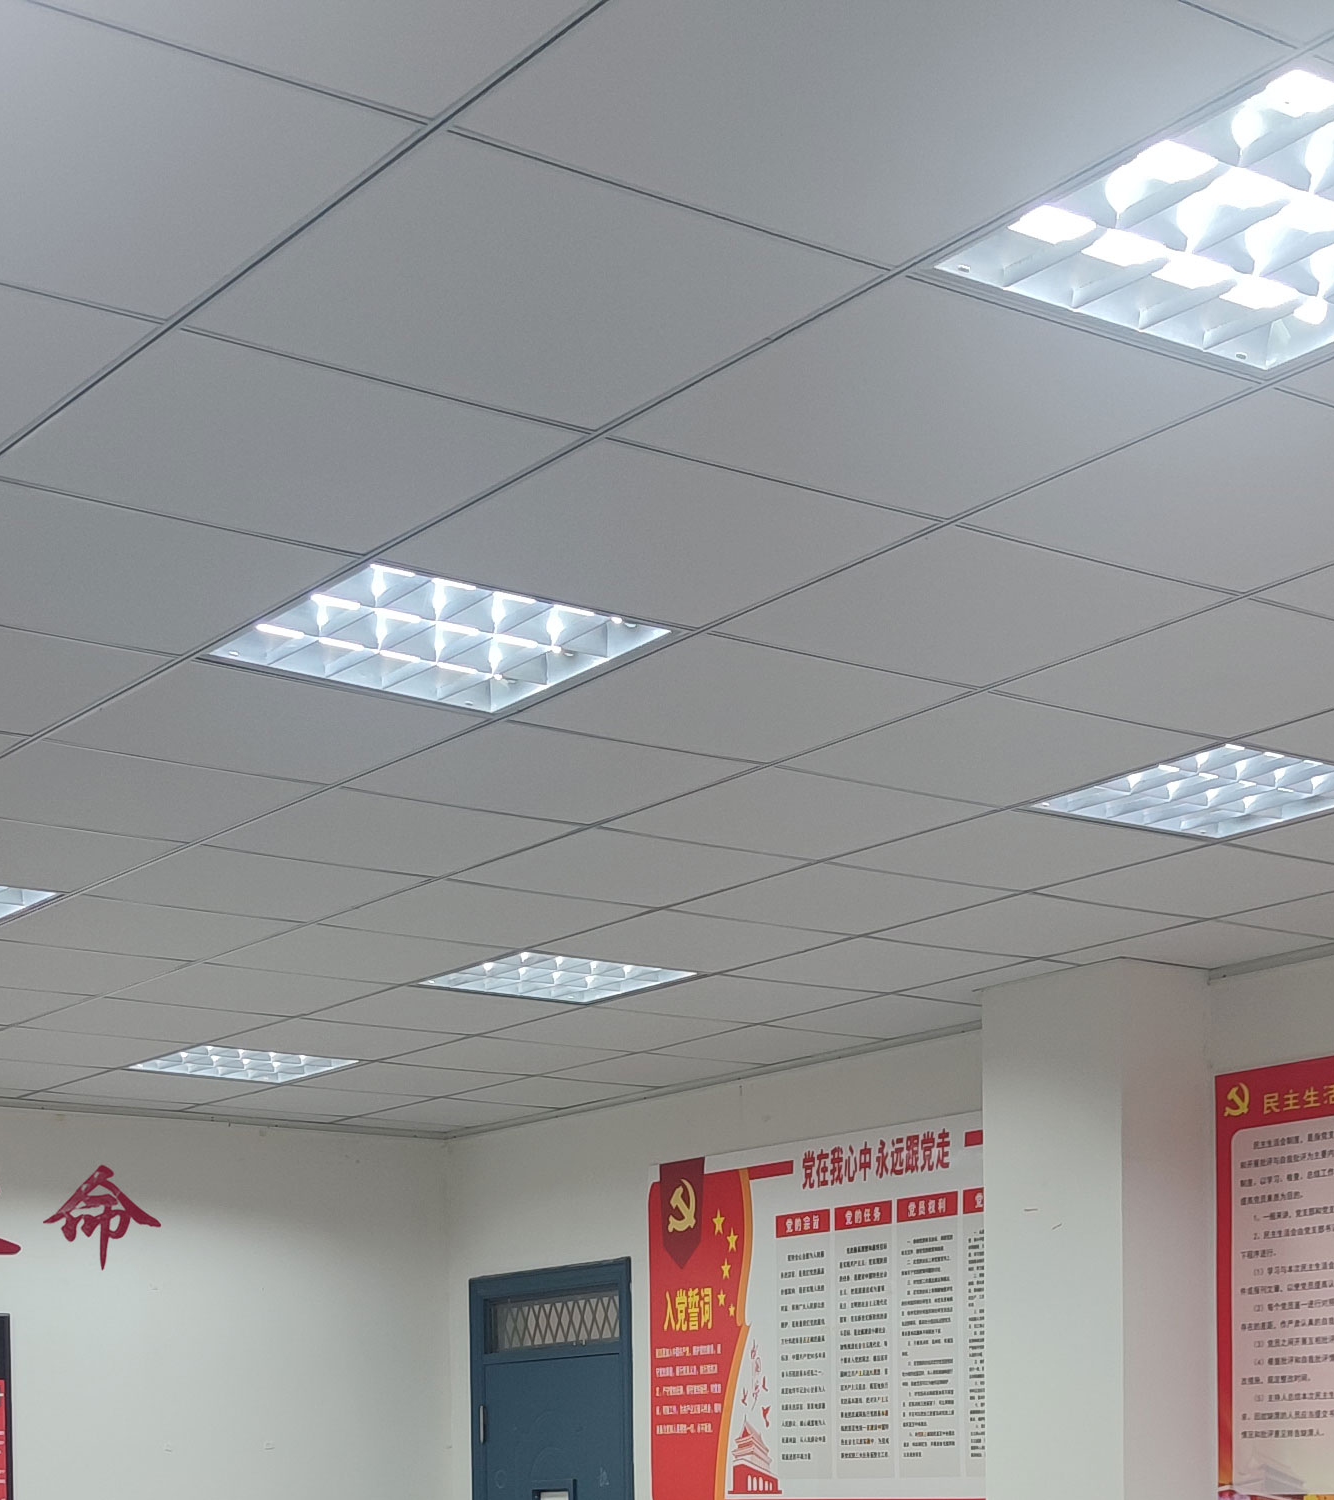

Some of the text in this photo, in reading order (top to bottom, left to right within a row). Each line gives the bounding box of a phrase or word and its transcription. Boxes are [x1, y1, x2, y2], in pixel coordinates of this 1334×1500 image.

[802, 1128, 951, 1190] 党在我心中 永远跟党走
[845, 1206, 882, 1225] 党的任务
[907, 1197, 947, 1217] 党员权利
[785, 1215, 820, 1233] 党的宗旨
[662, 1287, 713, 1332] 入党誓词
